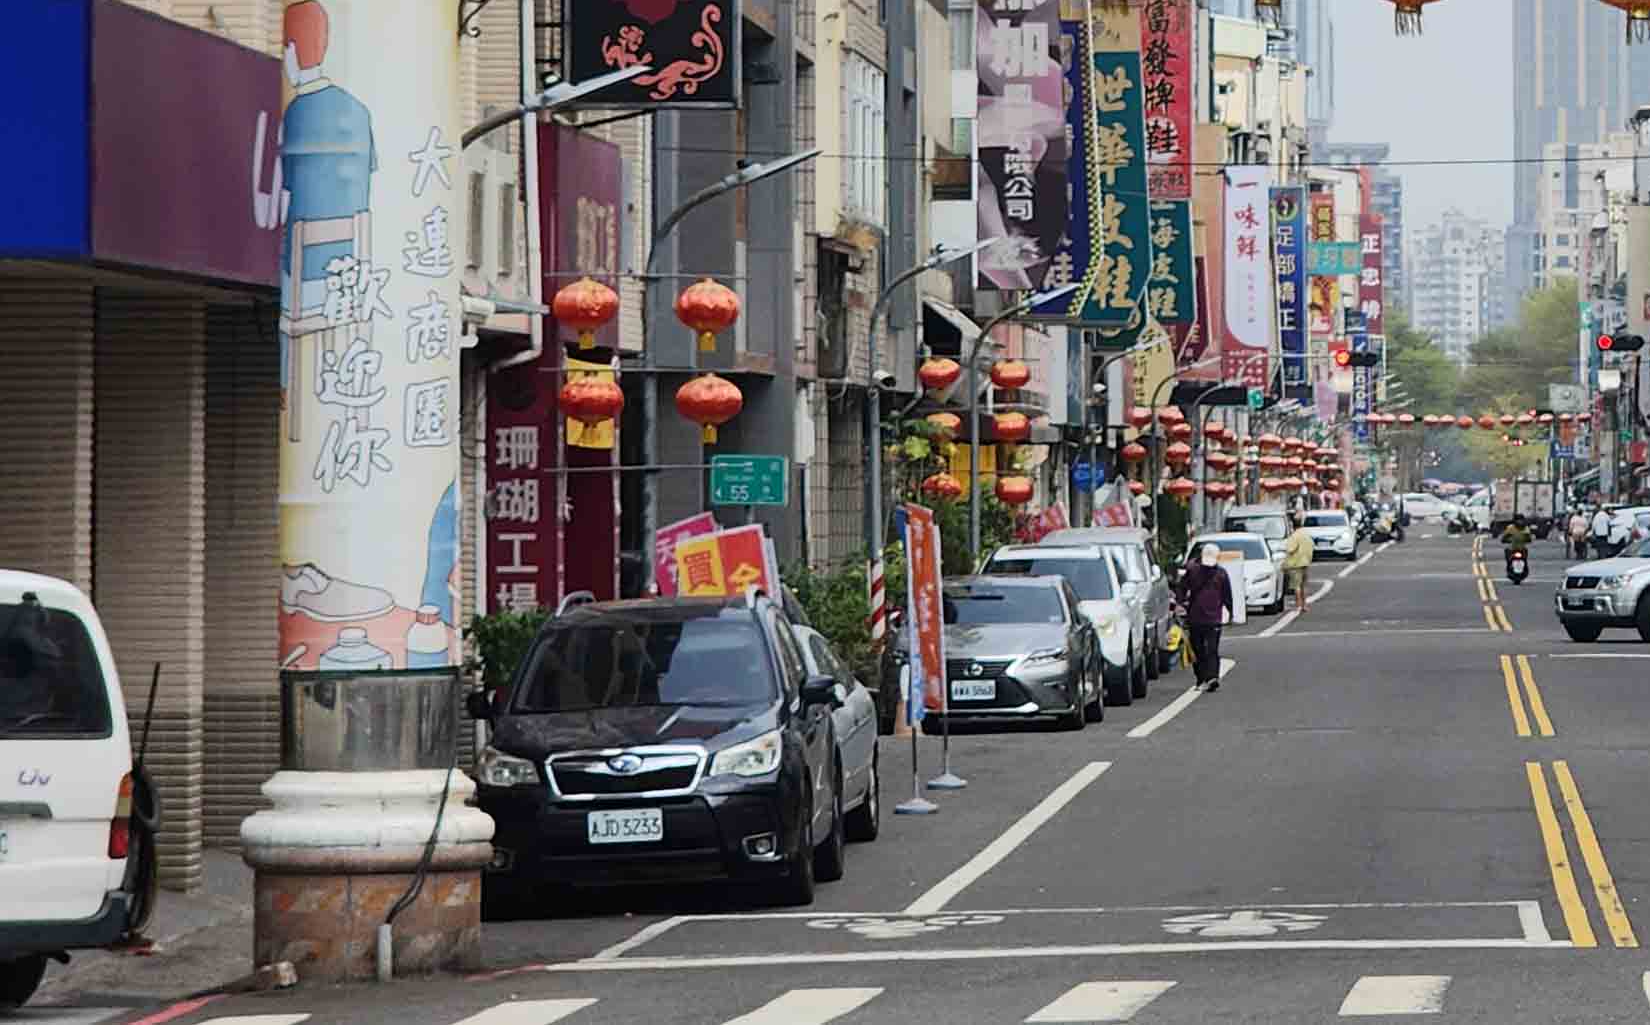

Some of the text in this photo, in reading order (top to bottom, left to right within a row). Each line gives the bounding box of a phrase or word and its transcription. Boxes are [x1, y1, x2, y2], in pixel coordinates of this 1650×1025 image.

[1149, 201, 1181, 317] 海皮鞋
[313, 254, 394, 494] 歡迎你
